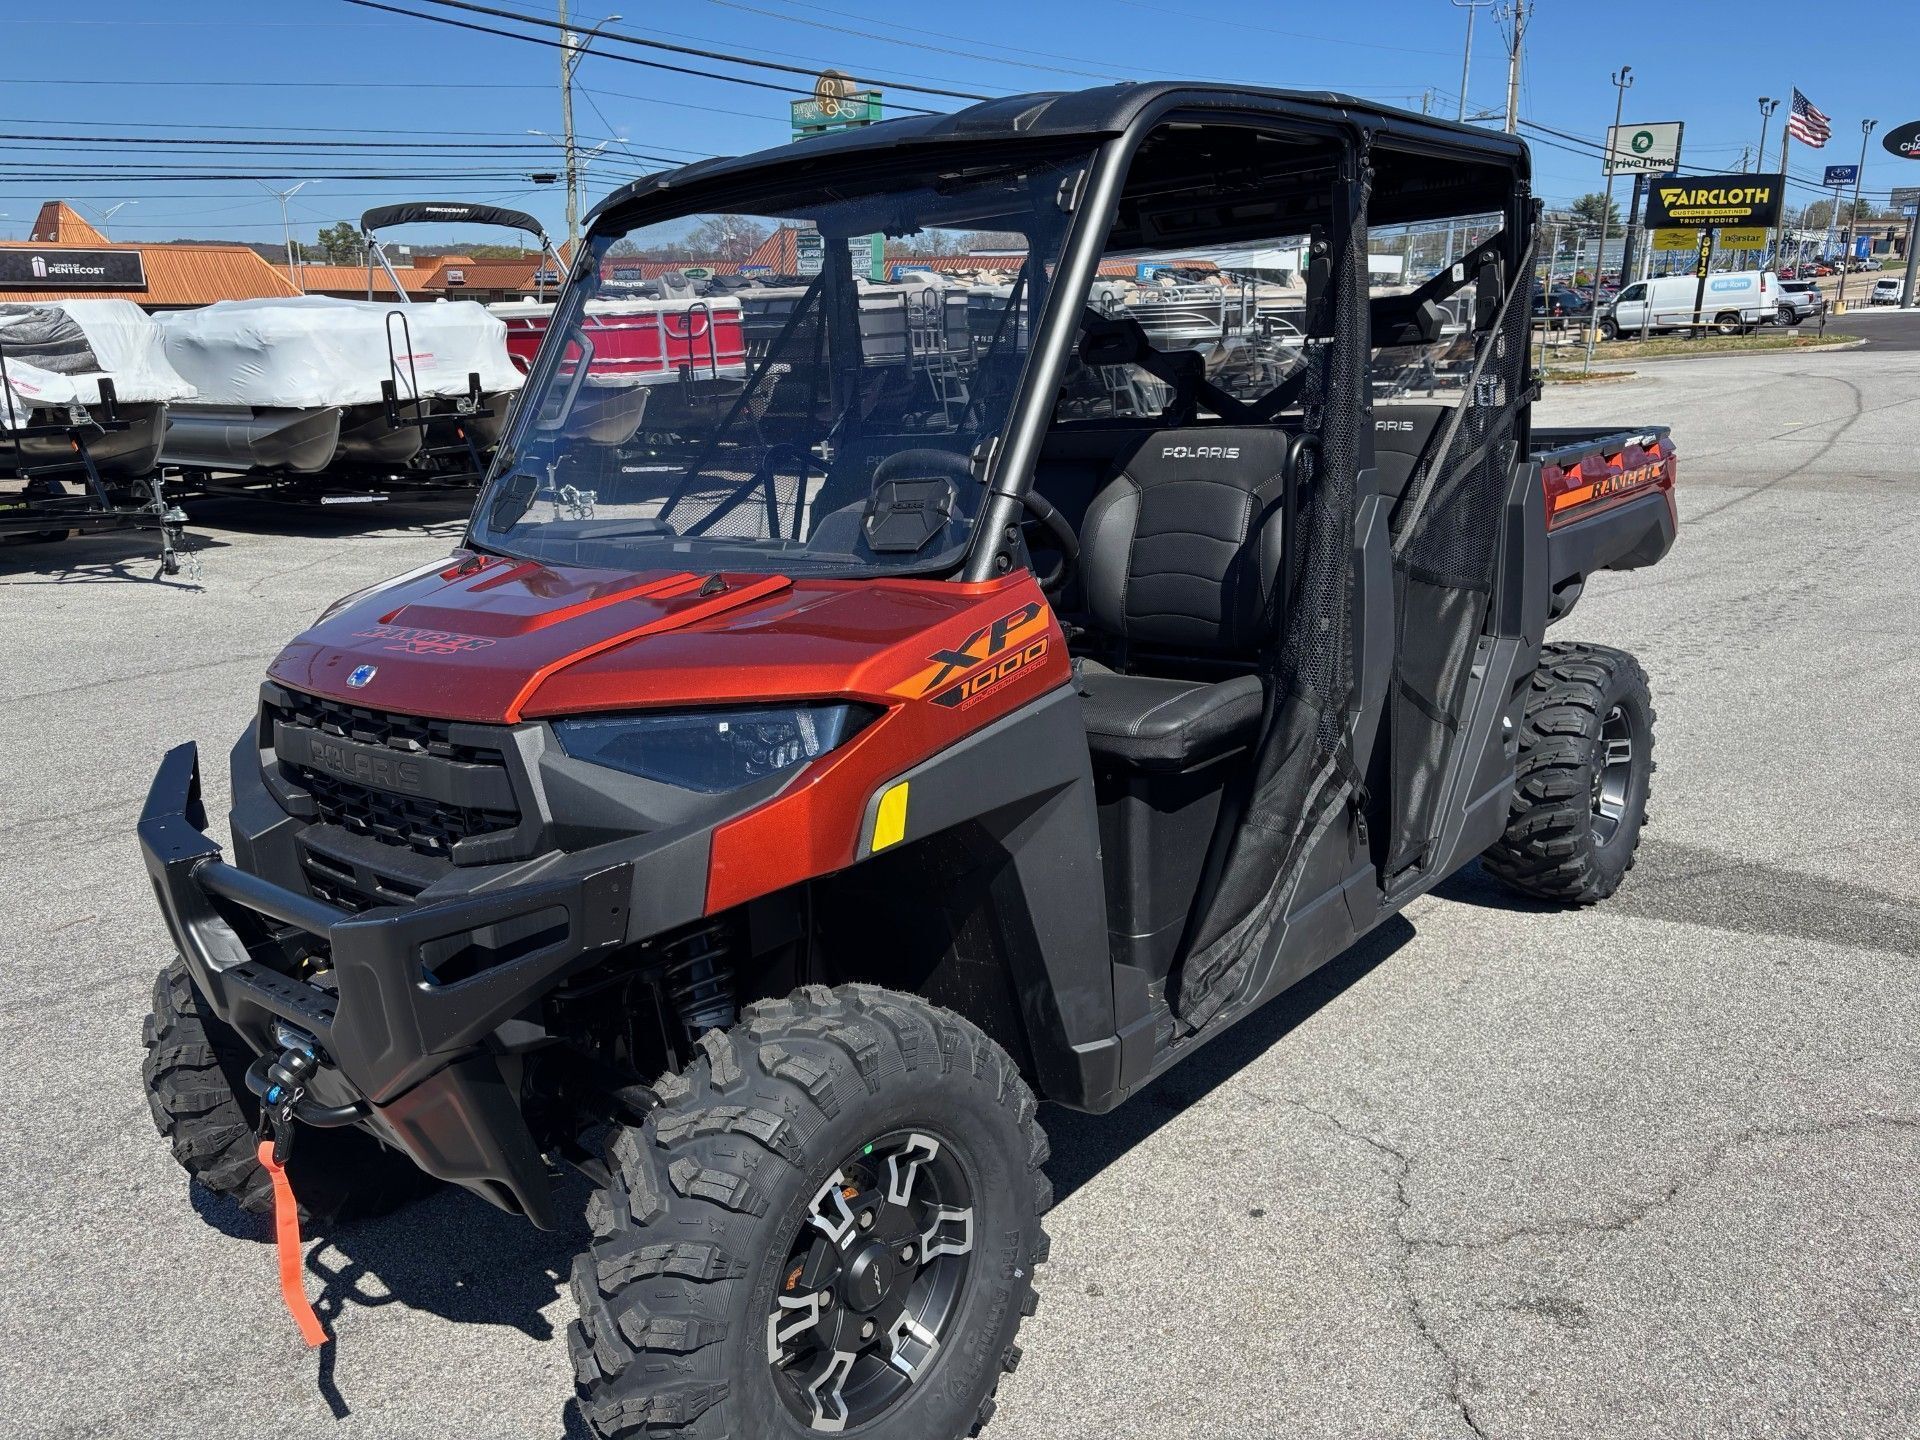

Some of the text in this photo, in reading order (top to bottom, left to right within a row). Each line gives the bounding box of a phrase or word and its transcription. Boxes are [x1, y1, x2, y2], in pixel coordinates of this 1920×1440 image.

[1605, 156, 1674, 170] DriveTime
[1660, 187, 1770, 208] FAIRCLOTH
[425, 206, 469, 214] PRINCECRAFT
[48, 266, 105, 275] PENTECOST
[1375, 420, 1414, 431] ARIS
[1162, 446, 1240, 459] POLARIS
[1592, 463, 1655, 499] RANGER
[921, 601, 1042, 695] XP
[960, 638, 1048, 700] 1000
[309, 737, 423, 791] POLARIS
